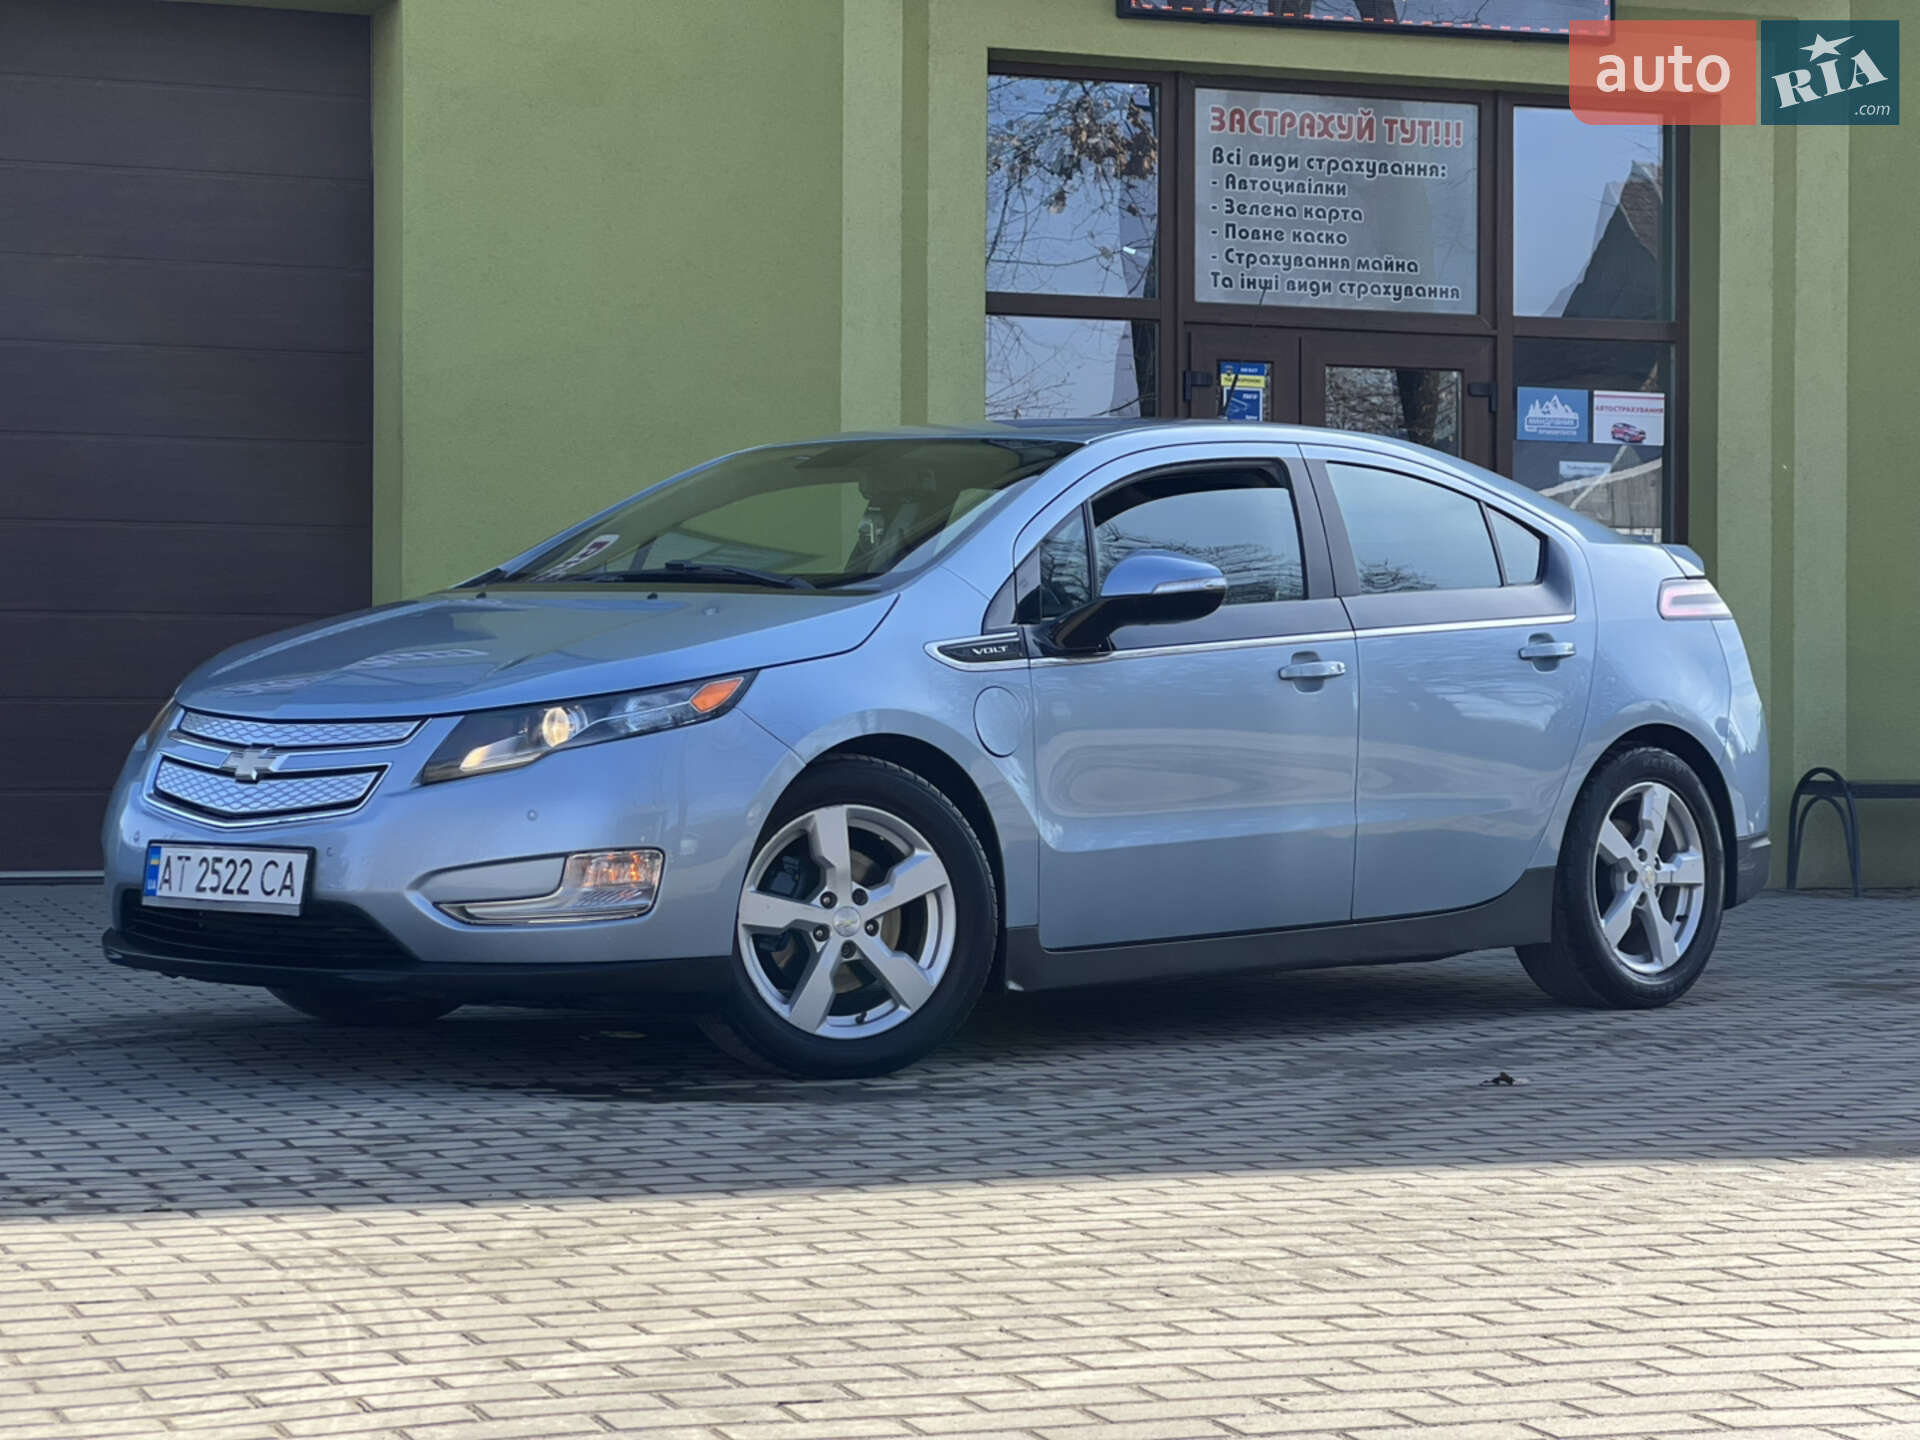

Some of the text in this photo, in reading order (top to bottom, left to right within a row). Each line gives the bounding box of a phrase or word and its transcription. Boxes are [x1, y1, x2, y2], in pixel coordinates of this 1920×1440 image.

[1210, 107, 1463, 147] ЗАСТРАХУЙ ТУТ!!!
[1211, 146, 1447, 178] Всі види страхування:
[1225, 174, 1347, 196] Автоцивілки
[1224, 199, 1297, 218] Зелена
[1304, 206, 1363, 224] карта
[1224, 223, 1285, 242] Повне
[1292, 230, 1348, 245] каско
[1224, 248, 1350, 271] Страхування
[1356, 256, 1419, 273] майна
[1211, 272, 1460, 301] Та інші види страхування
[972, 645, 1009, 655] VOLT
[159, 855, 295, 898] AT 2522 CA
